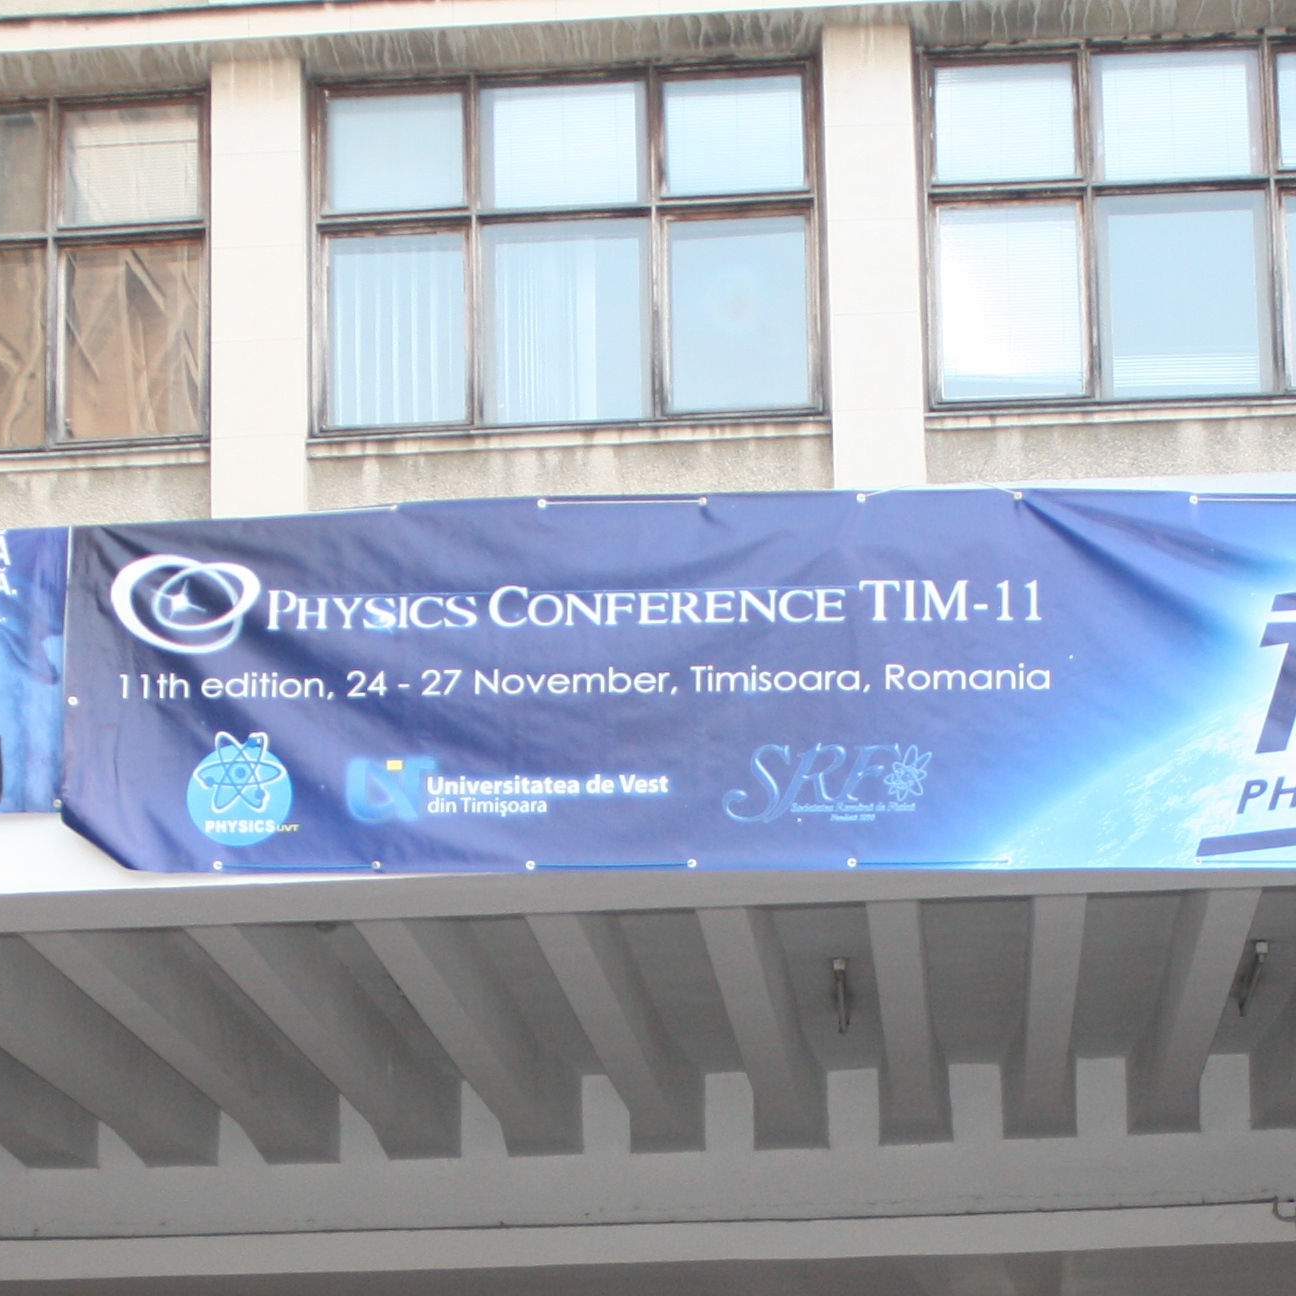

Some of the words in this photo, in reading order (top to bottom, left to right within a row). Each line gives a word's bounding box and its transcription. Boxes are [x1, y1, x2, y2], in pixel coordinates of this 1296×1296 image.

[266, 588, 479, 631] PHYSICS
[488, 584, 846, 629] CONFERENCE
[858, 578, 1043, 622] TIM-11
[119, 672, 190, 700] 11th
[200, 671, 336, 701] edition,
[346, 669, 388, 698] 24
[420, 668, 463, 697] 27
[473, 666, 678, 696] November,
[690, 664, 871, 694] Timisoara,
[885, 662, 1052, 692] Romania
[426, 774, 580, 796] Universitatea
[585, 773, 615, 794] de
[618, 773, 669, 794] Vest
[426, 797, 456, 814] din
[204, 819, 276, 834] PHYSICS
